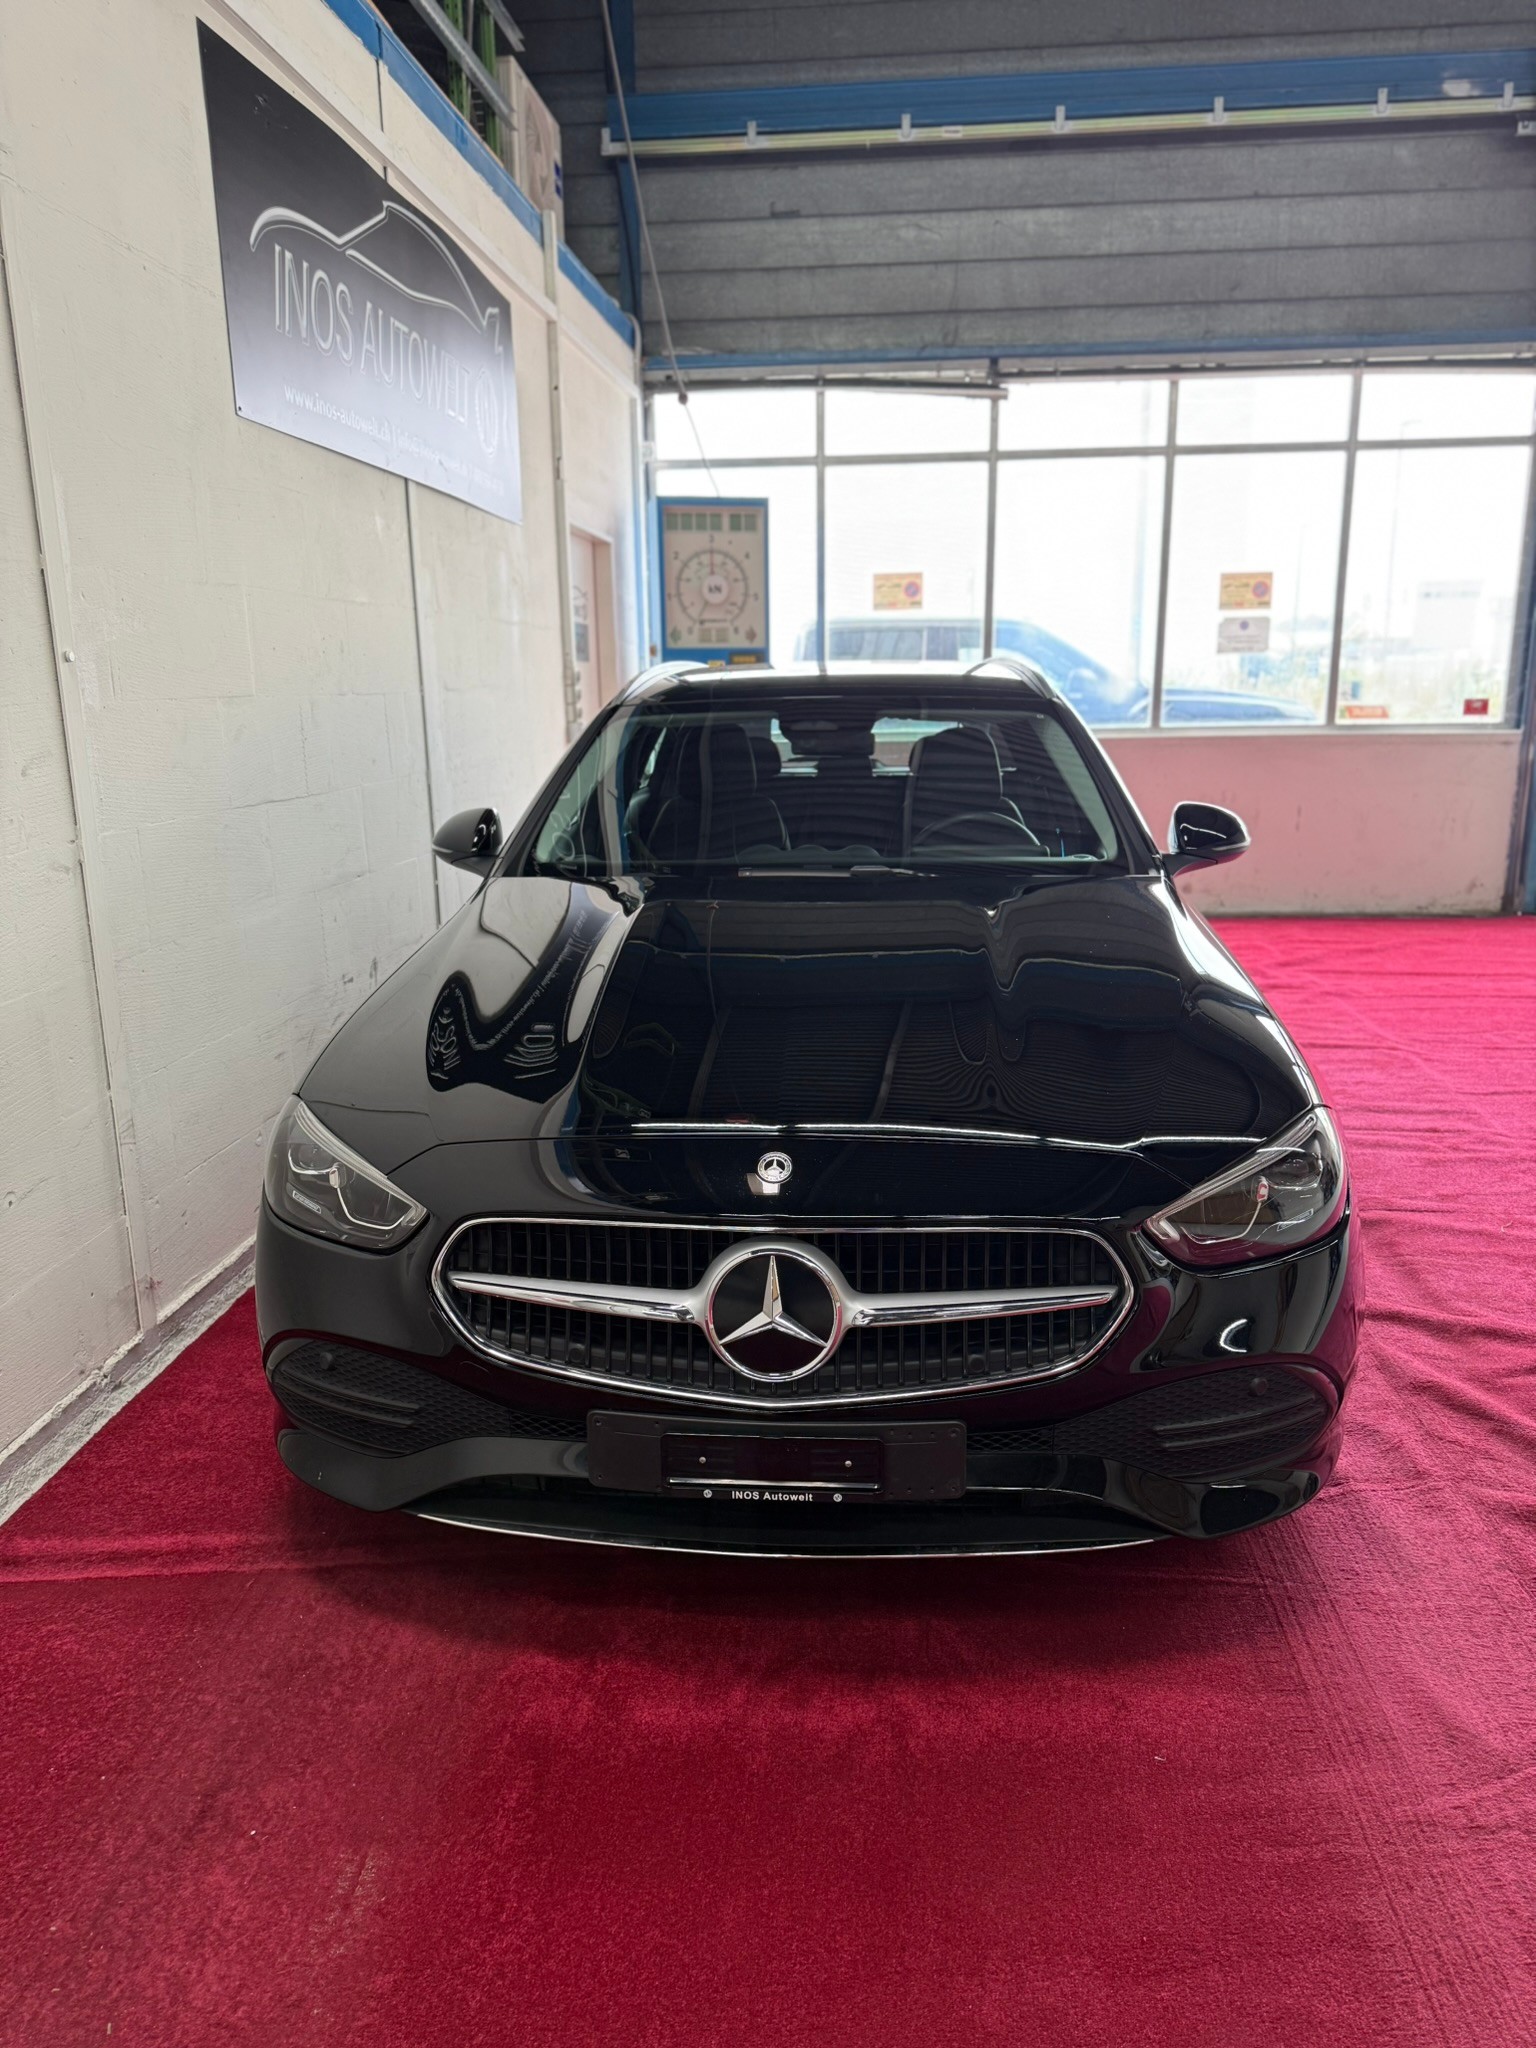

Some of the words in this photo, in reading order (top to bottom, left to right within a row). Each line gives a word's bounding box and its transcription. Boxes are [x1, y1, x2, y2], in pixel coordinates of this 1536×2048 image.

[274, 242, 355, 367] INOS
[731, 1490, 760, 1501] INOS
[763, 1491, 814, 1502] Autowelt
